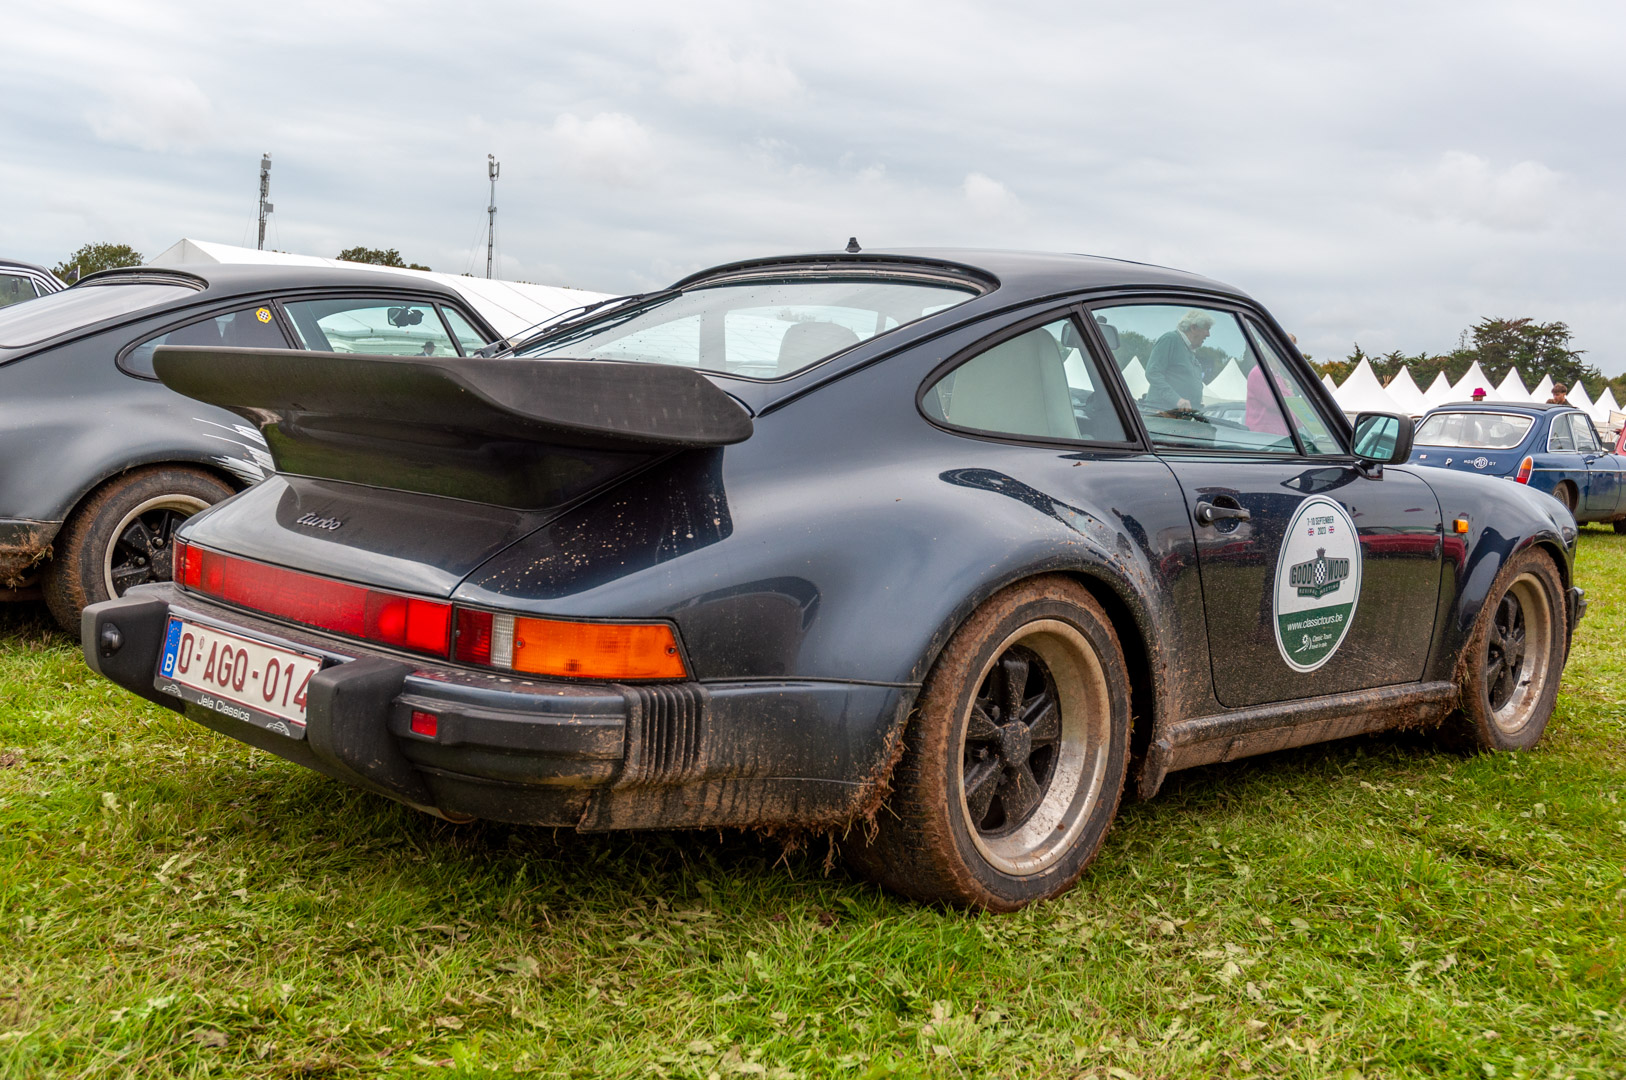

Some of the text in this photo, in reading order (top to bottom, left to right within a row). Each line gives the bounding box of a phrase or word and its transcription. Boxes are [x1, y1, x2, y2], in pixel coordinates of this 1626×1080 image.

[296, 512, 342, 530] turbo
[1315, 516, 1334, 525] SEPTEMBER
[1317, 526, 1327, 536] 2023
[1287, 613, 1343, 631] www.classictours.be
[164, 653, 174, 673] B
[197, 694, 250, 722] Jela Classics
